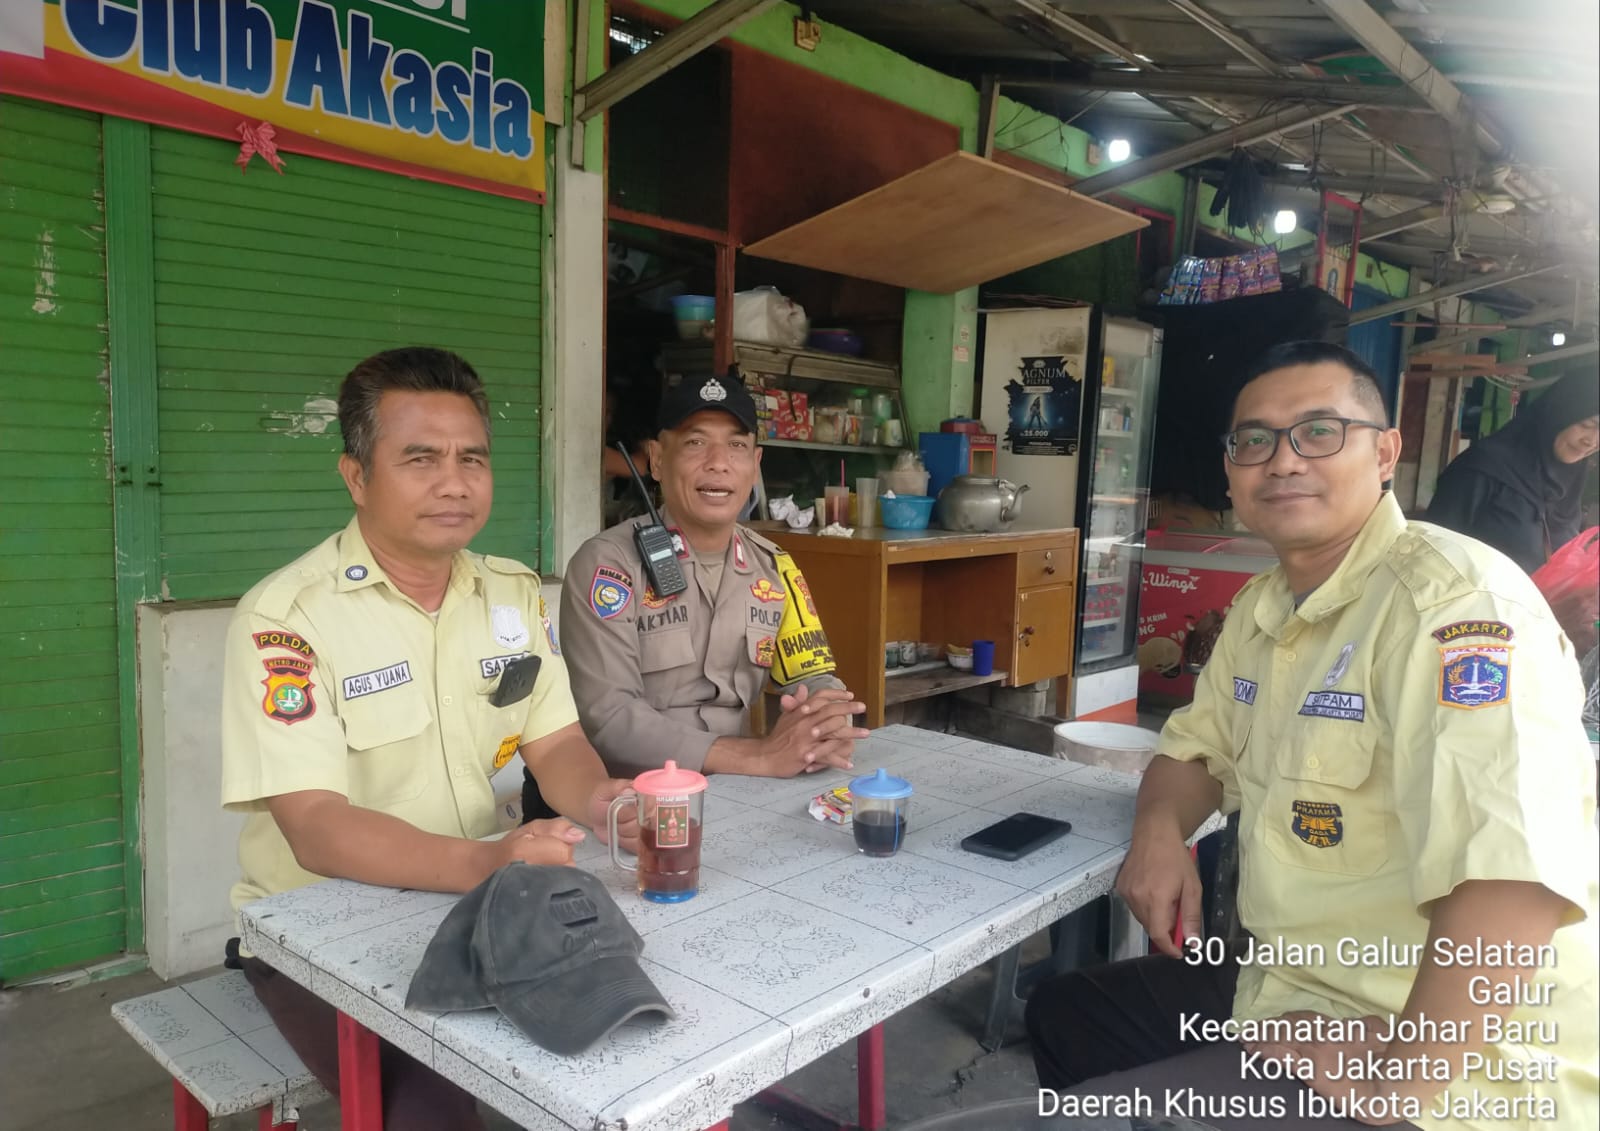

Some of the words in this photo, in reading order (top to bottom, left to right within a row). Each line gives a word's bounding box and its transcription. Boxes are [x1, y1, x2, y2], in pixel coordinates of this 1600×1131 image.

[283, 0, 534, 160] Akasia
[1149, 571, 1198, 593] Wings
[1444, 623, 1508, 639] JAKARTA
[259, 633, 312, 655] POLDA
[348, 676, 373, 696] AGUS
[375, 665, 408, 688] YUANA
